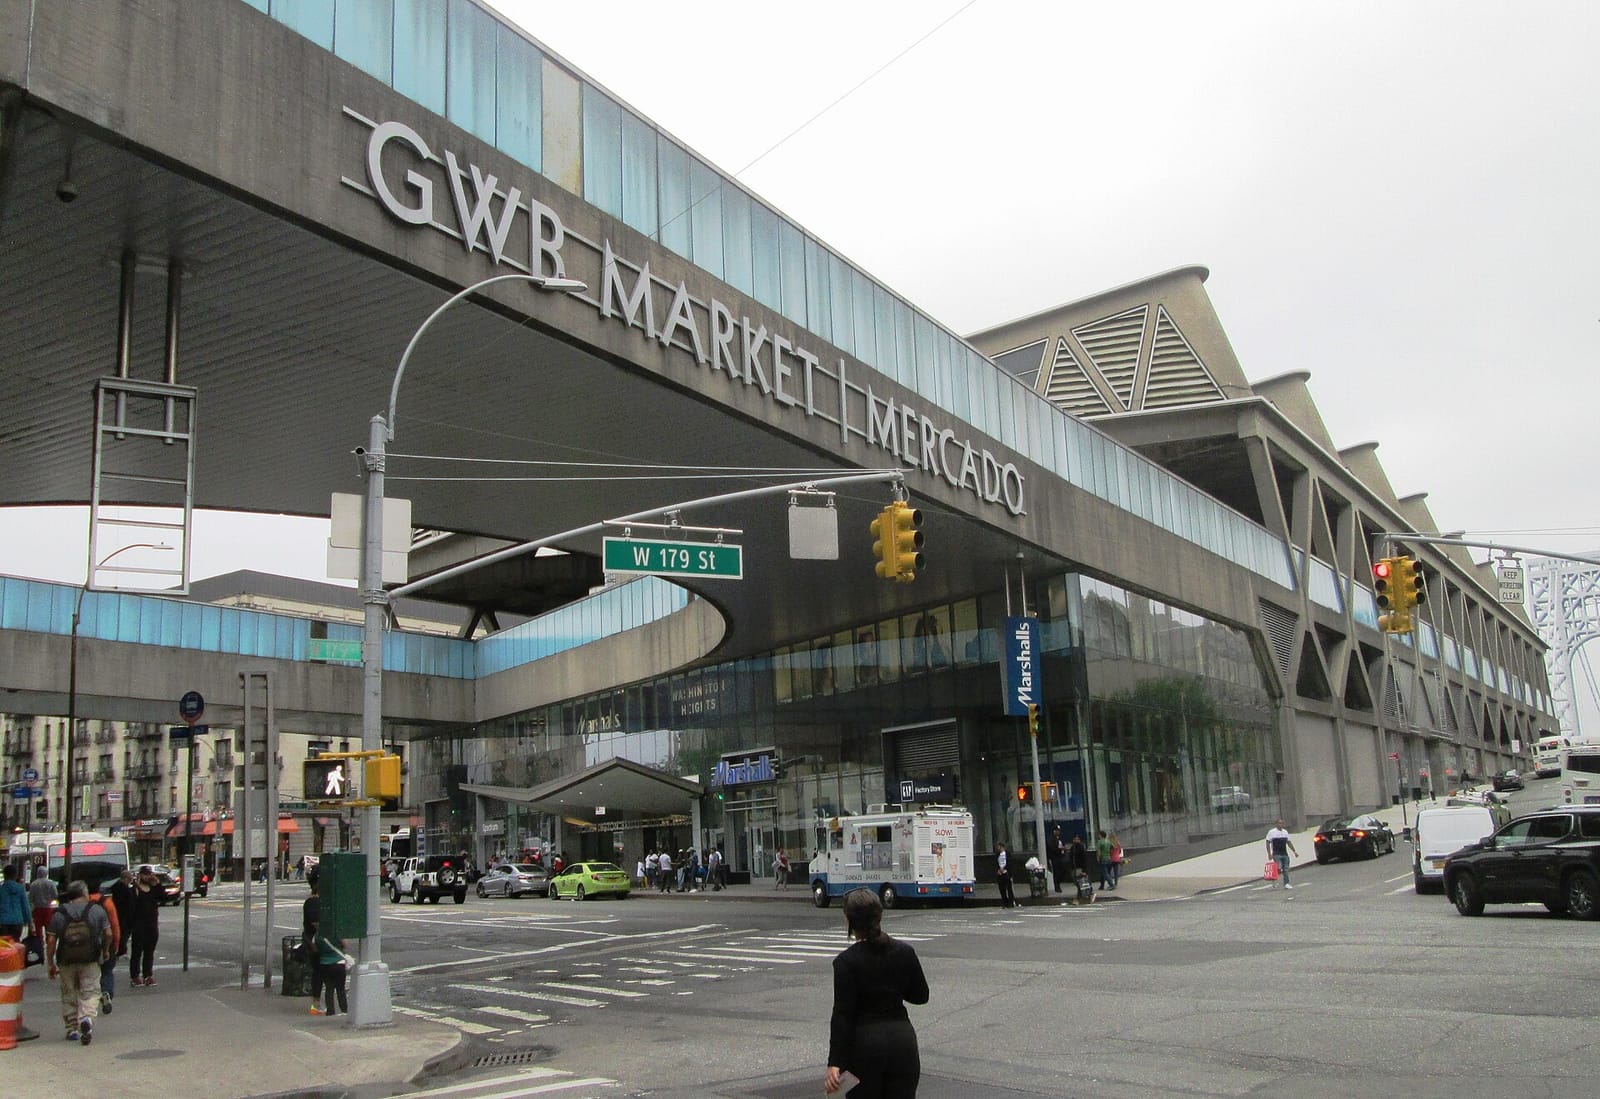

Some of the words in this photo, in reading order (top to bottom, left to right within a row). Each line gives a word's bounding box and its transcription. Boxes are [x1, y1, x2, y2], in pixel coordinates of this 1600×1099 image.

[366, 121, 567, 284] GWB
[600, 240, 819, 417] MARKET
[865, 384, 1026, 516] MERCADO
[633, 546, 650, 567] W
[659, 548, 690, 569] 179
[699, 550, 716, 570] St
[1503, 571, 1518, 579] KEEP
[1502, 591, 1521, 600] CLEAR
[1015, 622, 1032, 707] Marshalls
[711, 755, 775, 786] Marshalls
